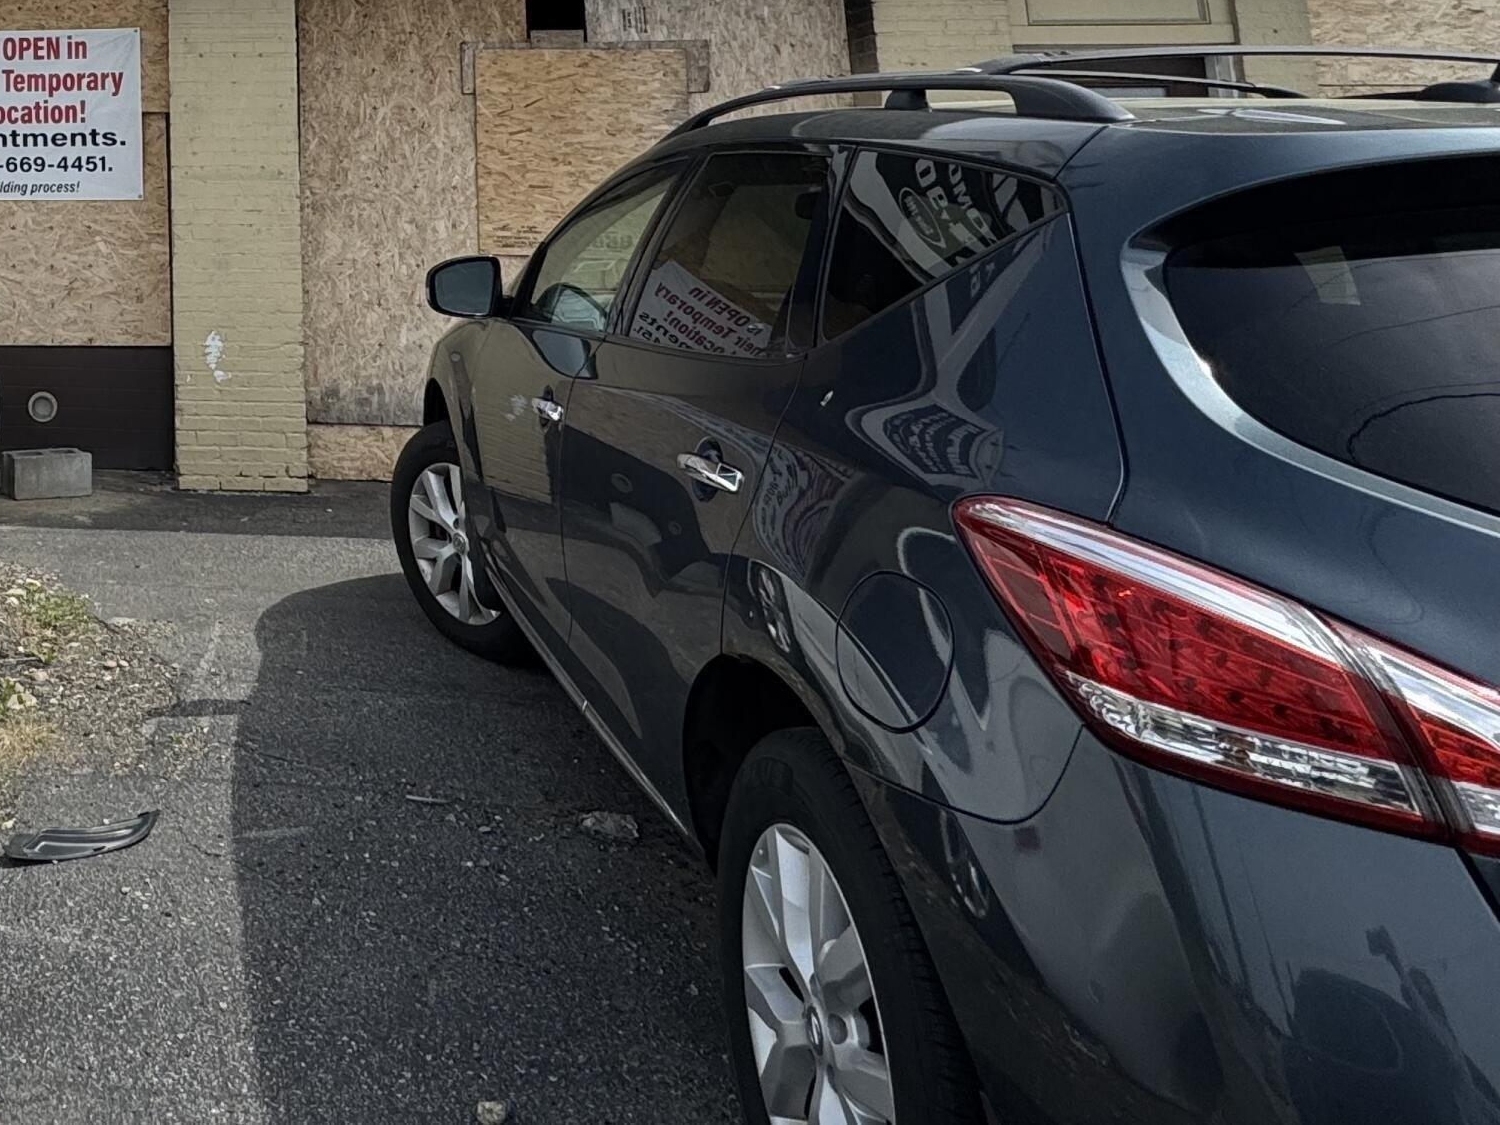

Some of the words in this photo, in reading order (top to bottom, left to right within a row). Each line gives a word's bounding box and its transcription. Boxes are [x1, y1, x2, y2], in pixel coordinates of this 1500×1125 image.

[2, 37, 60, 61] OPEN
[67, 36, 88, 60] in
[4, 69, 124, 96] Temporary
[30, 180, 80, 195] process!
